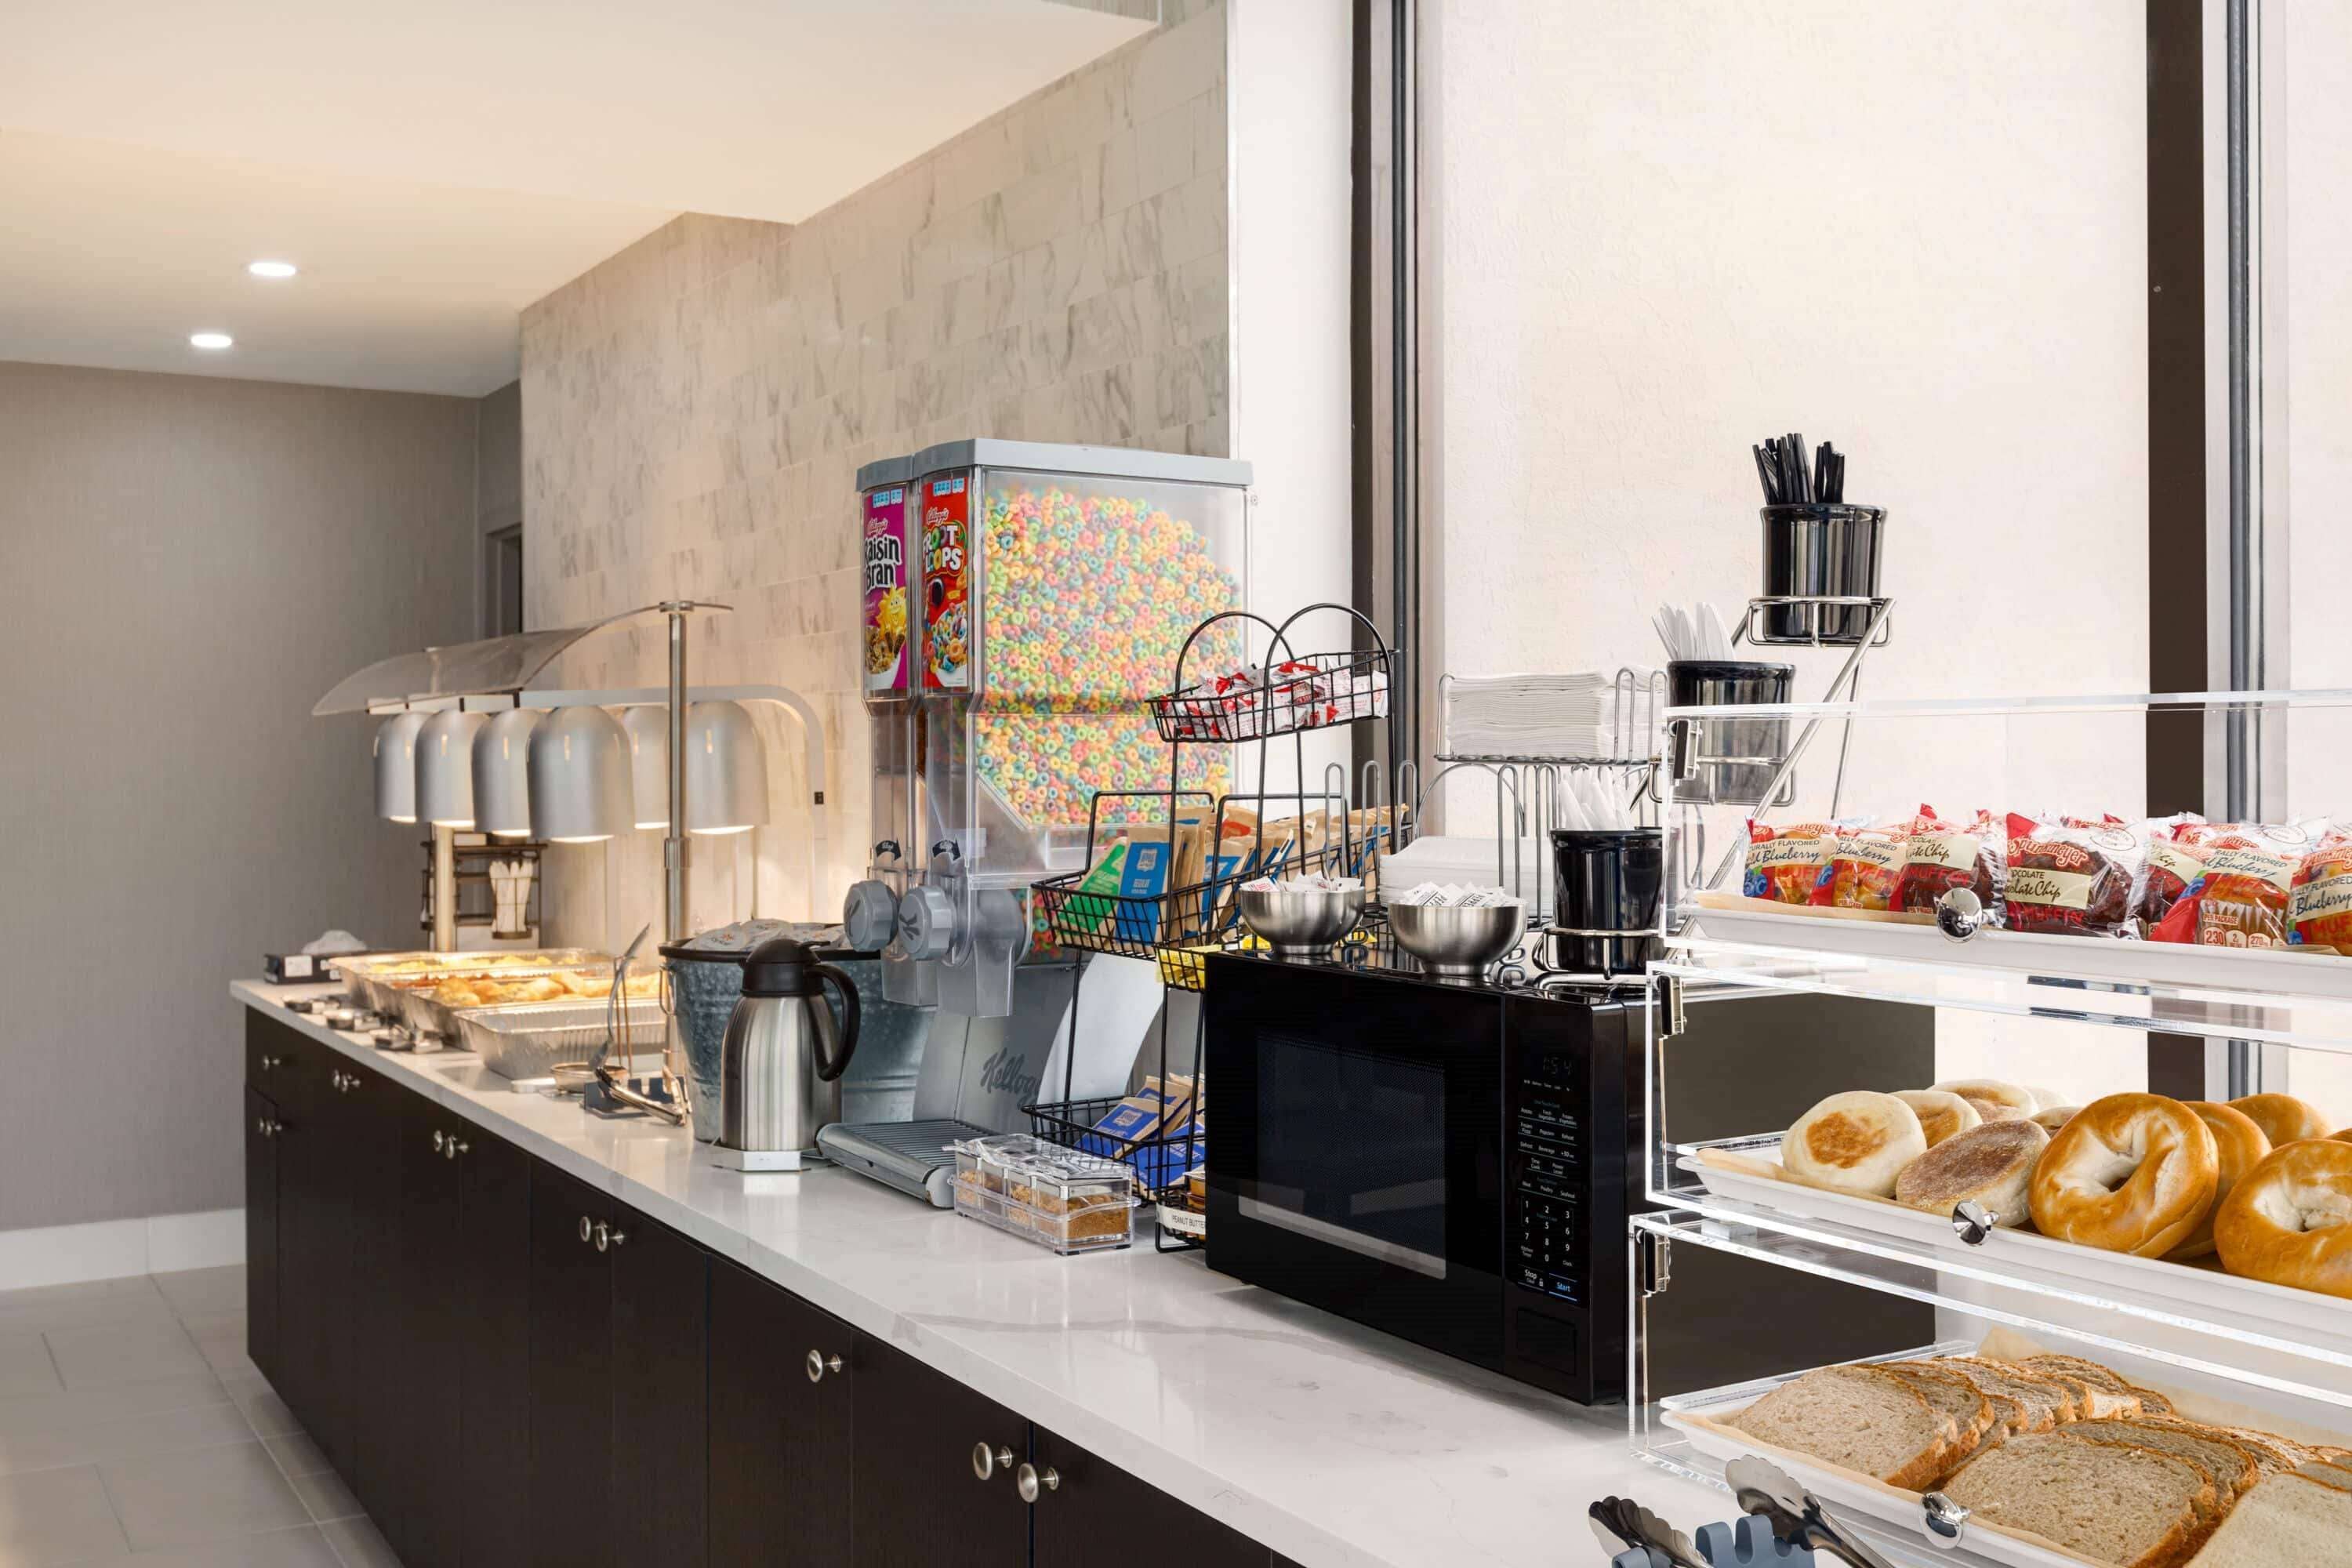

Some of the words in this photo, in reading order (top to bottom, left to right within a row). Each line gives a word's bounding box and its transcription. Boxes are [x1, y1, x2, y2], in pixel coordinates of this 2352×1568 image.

[923, 525, 958, 555] FROOT
[925, 546, 963, 573] LOOPS
[1762, 847, 1820, 863] Blueberry
[1836, 843, 1893, 865] Blueberry
[1925, 844, 1950, 862] Chip
[2212, 856, 2278, 877] Blueberry
[2240, 852, 2288, 868] FLAVORED
[2034, 880, 2061, 902] Chip
[2296, 891, 2352, 915] Blueberry
[2215, 915, 2238, 924] PACKAGE
[2206, 931, 2223, 944] 230
[1525, 1200, 1529, 1209] 1
[1544, 1205, 1549, 1214] 2
[1172, 1215, 1189, 1226] PEANUT
[1565, 1210, 1570, 1219] 3
[1565, 1227, 1570, 1236] 6
[1544, 1237, 1549, 1246] 8
[1524, 1269, 1537, 1280] Stop
[1555, 1282, 1571, 1293] Start
